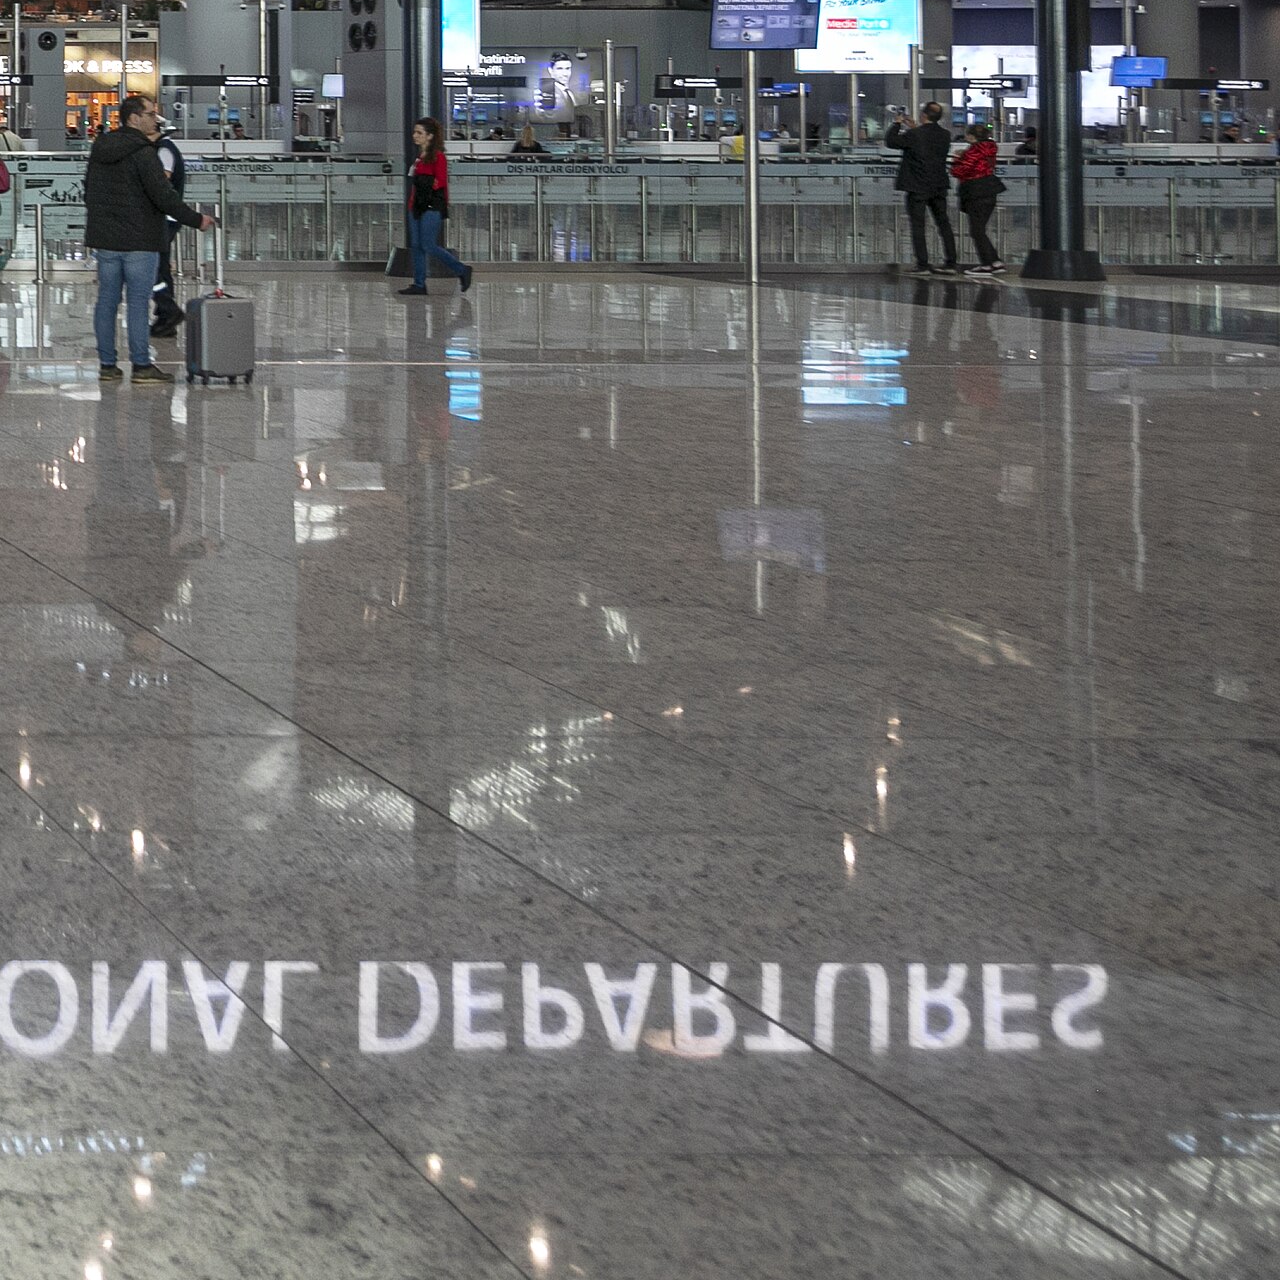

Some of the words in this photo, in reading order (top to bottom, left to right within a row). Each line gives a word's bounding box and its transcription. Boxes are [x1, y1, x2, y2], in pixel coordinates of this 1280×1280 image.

[10, 76, 21, 84] 40
[212, 164, 274, 173] DEPARTURES
[525, 165, 564, 174] HATLAR
[596, 165, 629, 174] YOLCU
